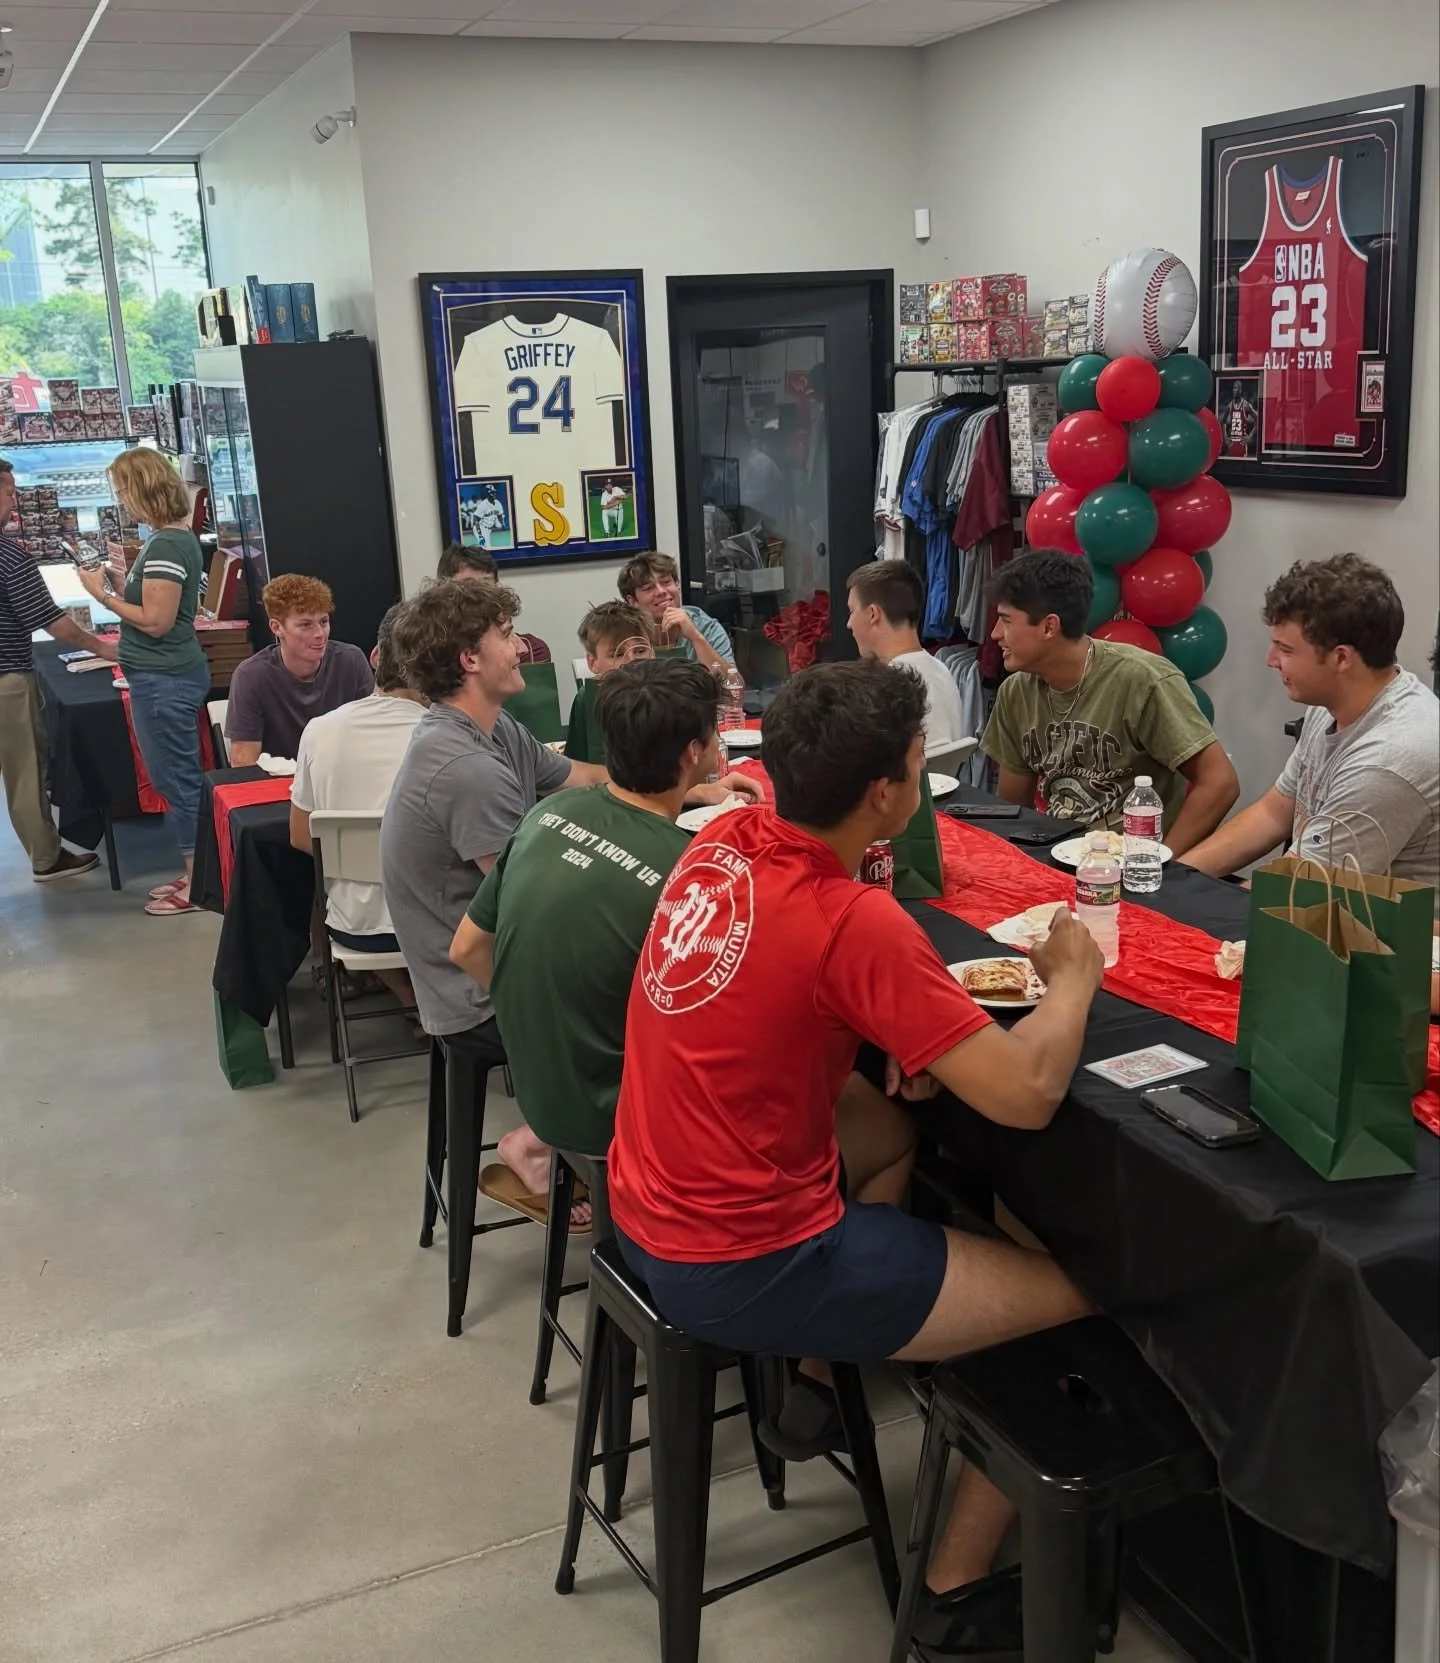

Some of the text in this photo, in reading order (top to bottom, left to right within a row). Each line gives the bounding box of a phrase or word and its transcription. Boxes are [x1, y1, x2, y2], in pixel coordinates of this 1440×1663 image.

[1288, 242, 1325, 281] NBA
[1270, 283, 1327, 348] 23
[504, 342, 576, 371] GRIFFEY
[507, 375, 575, 434] 24
[530, 482, 570, 546] S
[538, 812, 662, 887] THEY DON'T KNOW US
[561, 848, 594, 870] 2024
[706, 921, 747, 987] MUDITA
